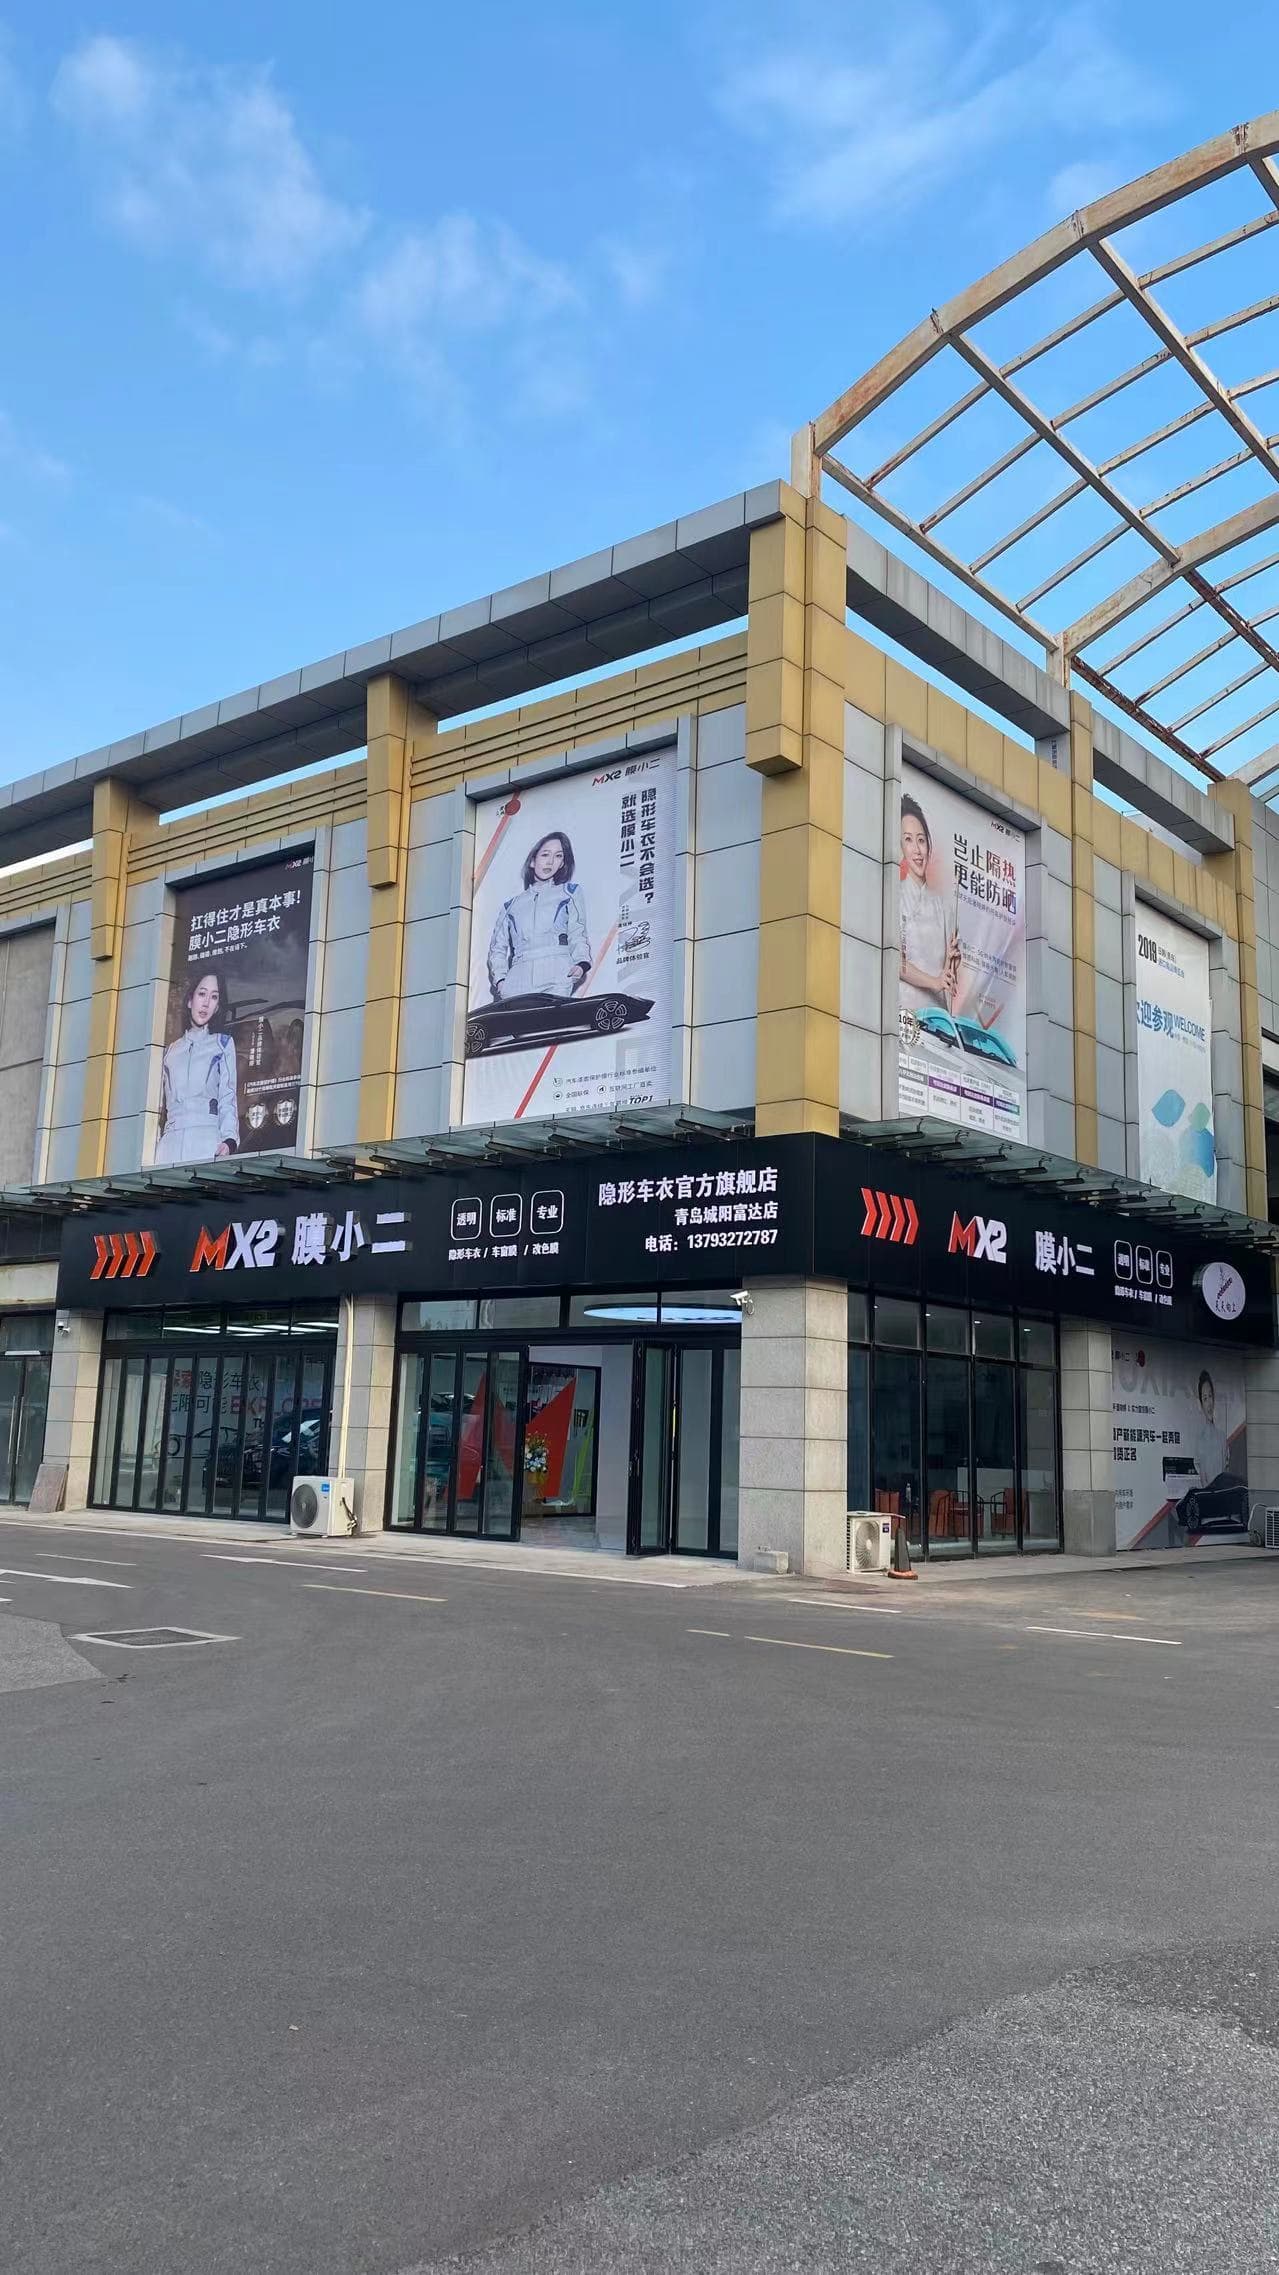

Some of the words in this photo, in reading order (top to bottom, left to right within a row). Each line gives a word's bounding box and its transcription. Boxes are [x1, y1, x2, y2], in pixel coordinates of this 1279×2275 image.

[592, 770, 622, 787] MX2
[625, 758, 660, 777] 膜小二
[620, 793, 637, 867] 就选膜小二
[639, 787, 657, 904] 隐形车衣不会选？
[954, 832, 1016, 888] 岂止隔热
[954, 860, 1016, 914] 更能防晒
[190, 889, 301, 932] 扛得住才是真本事！
[188, 914, 281, 952] 膜小二隐形车衣
[1136, 1000, 1174, 1039] 迎参观
[1173, 1013, 1206, 1042] WELCOME
[629, 1094, 654, 1106] TOP1
[598, 1166, 778, 1206] 隐形车衣官方旗舰店
[456, 1211, 477, 1226] 透明
[495, 1208, 517, 1223] 标准
[536, 1205, 558, 1220] 专业
[674, 1200, 778, 1226] 青岛城阳富达店
[189, 1218, 279, 1272] MX2
[291, 1210, 406, 1266] 膜小二
[448, 1247, 482, 1261] 隐形车衣
[532, 1241, 560, 1256] 改色膜
[947, 1210, 1007, 1264] MX2
[1035, 1230, 1095, 1276] 膜小二
